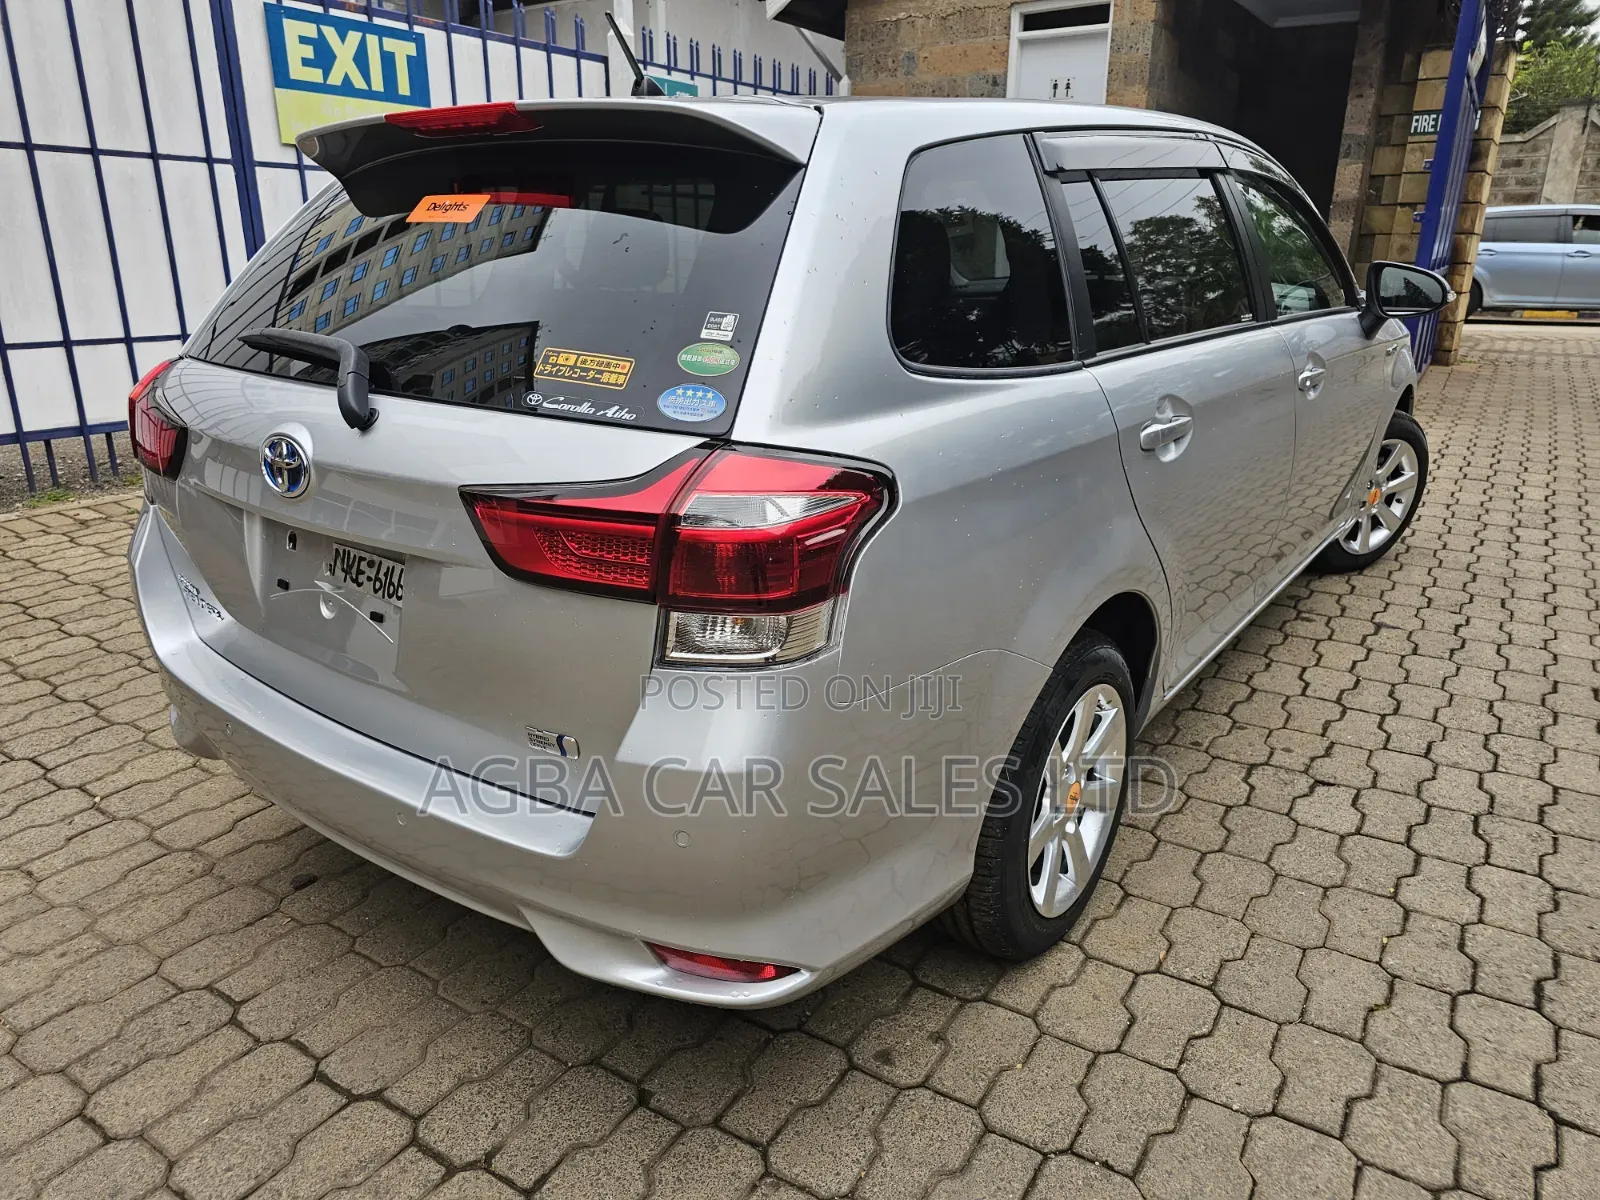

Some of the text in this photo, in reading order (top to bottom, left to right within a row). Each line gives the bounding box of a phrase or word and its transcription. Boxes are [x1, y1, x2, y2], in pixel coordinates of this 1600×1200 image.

[282, 18, 417, 96] EXIT
[1410, 114, 1437, 133] FIRE
[426, 201, 470, 213] Delights
[542, 397, 637, 421] Corolla Aiho
